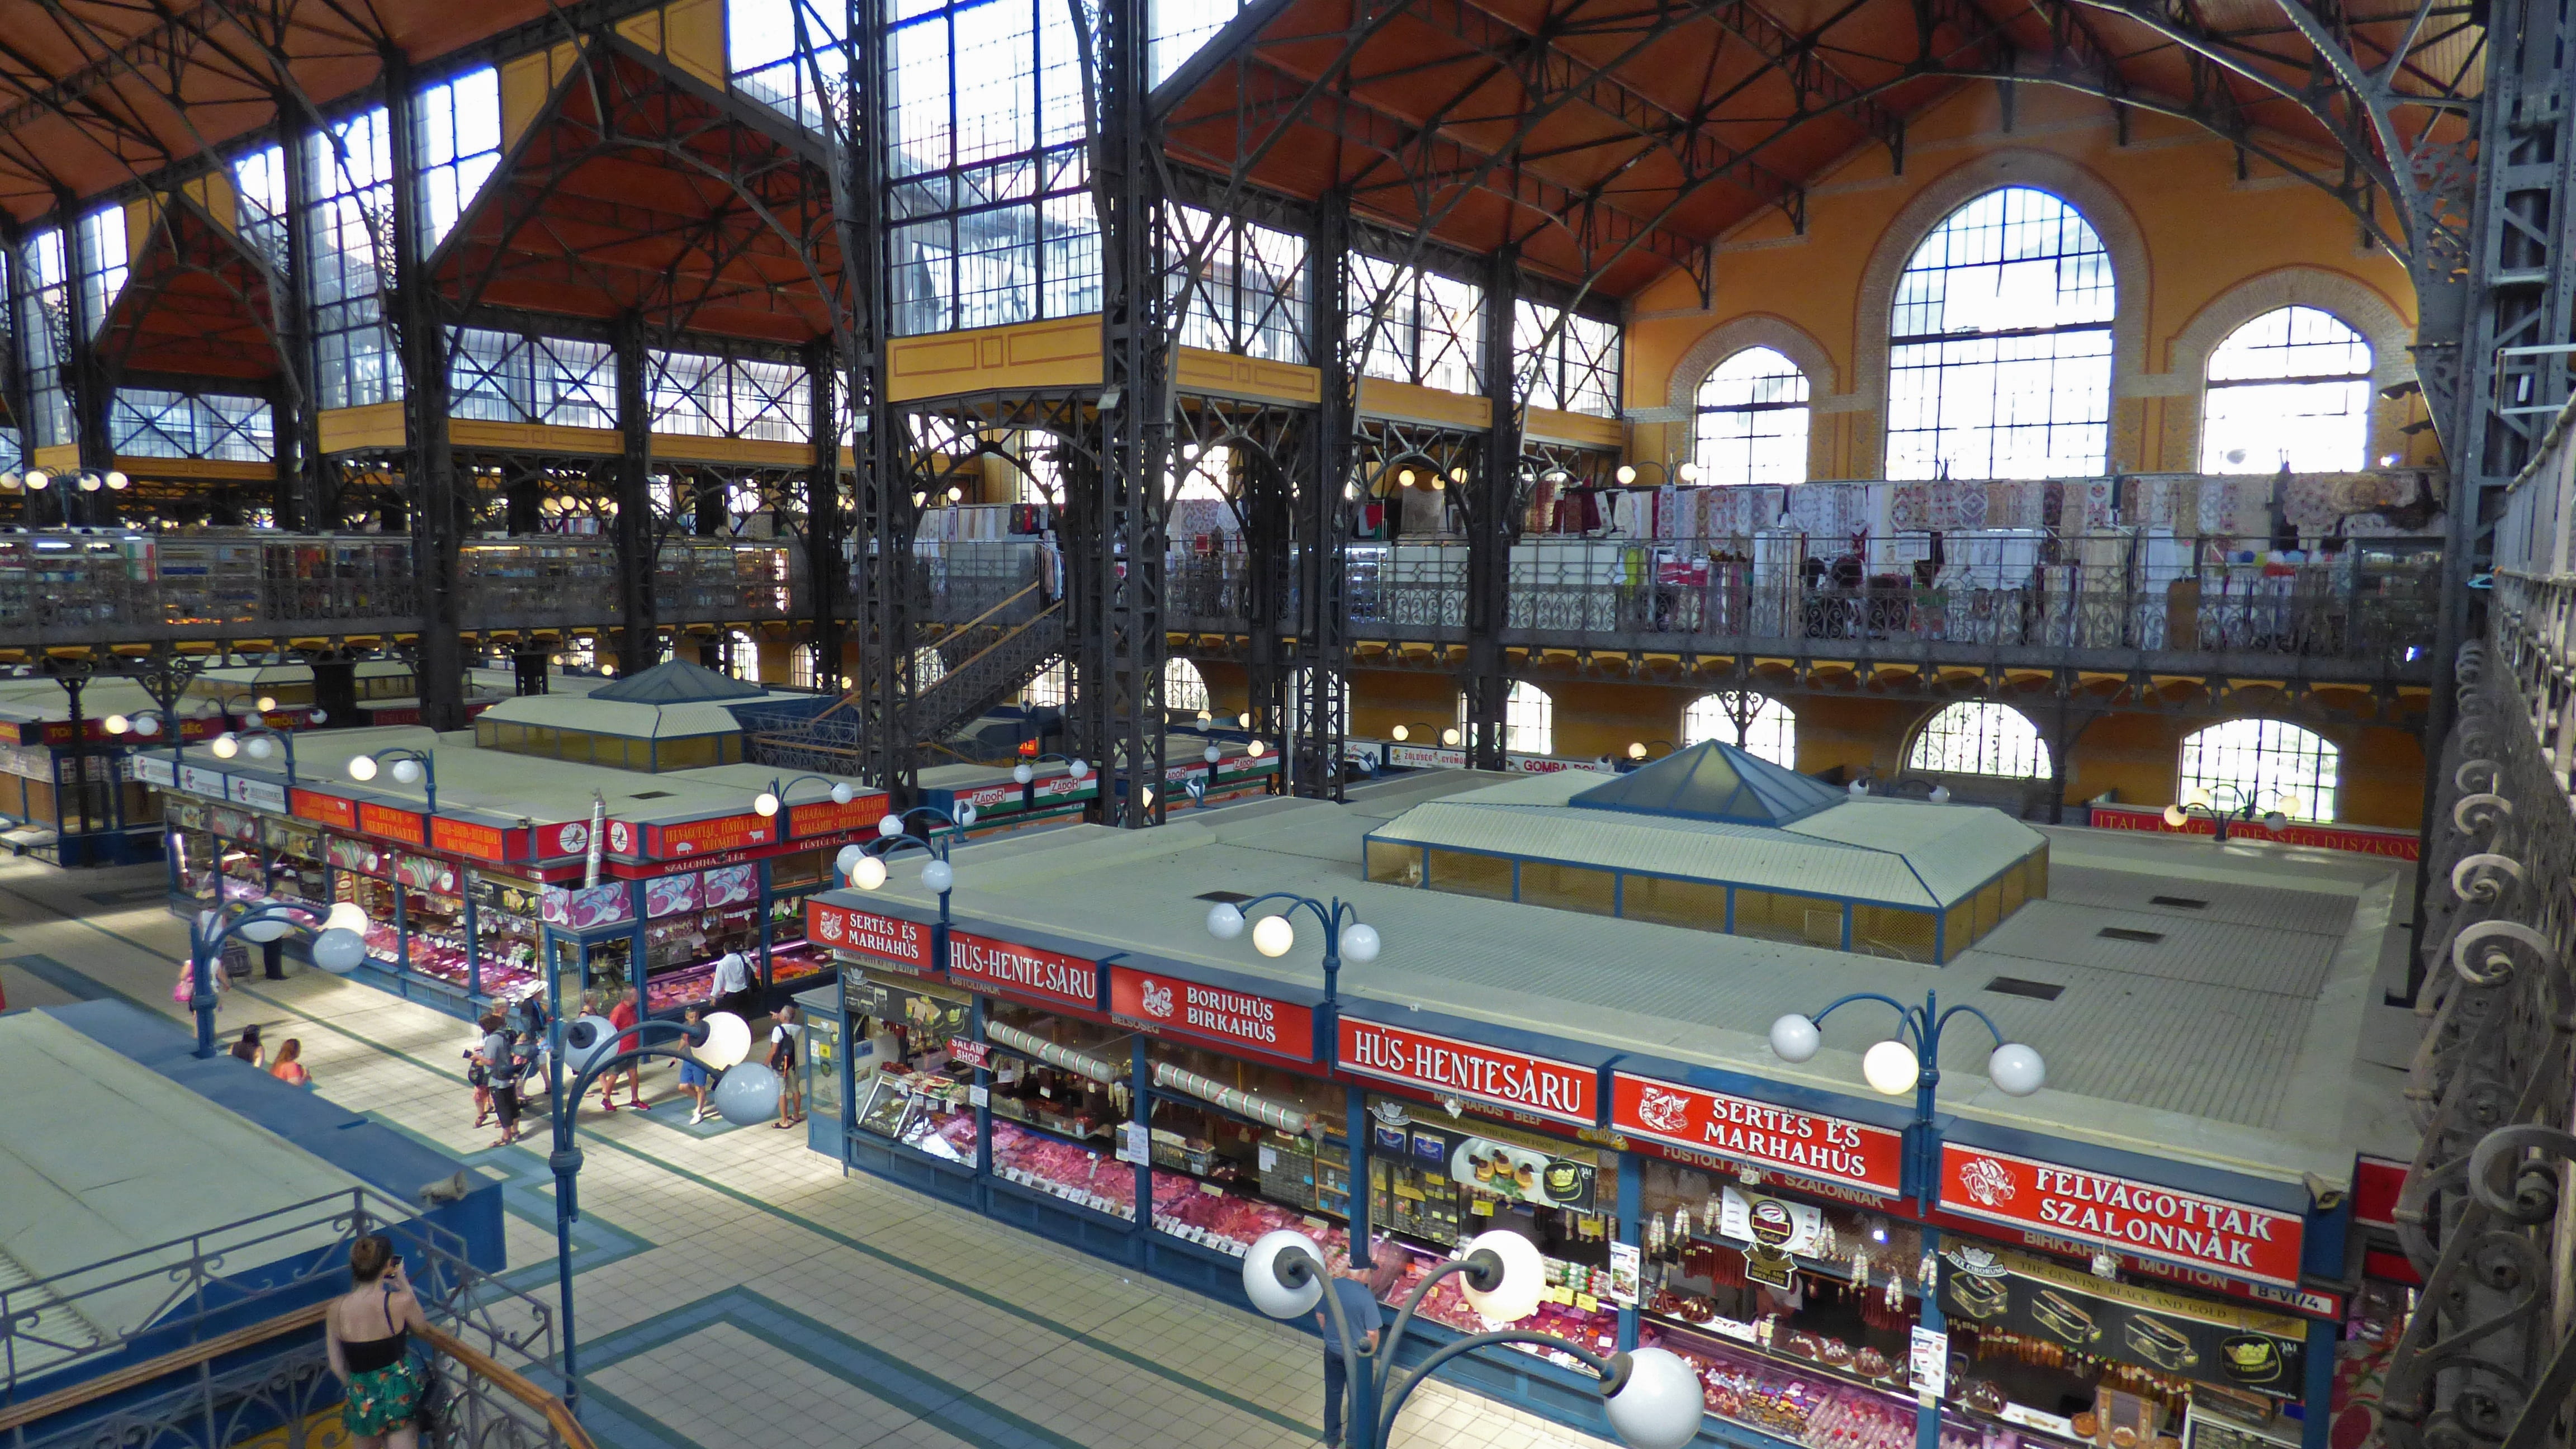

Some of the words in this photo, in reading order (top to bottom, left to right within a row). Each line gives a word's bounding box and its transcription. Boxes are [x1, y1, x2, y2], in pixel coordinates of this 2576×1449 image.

[1523, 760, 1567, 773] GOMBA
[850, 913, 894, 936] SERTÉS
[902, 921, 917, 941] ÉS
[849, 930, 919, 960] MARHAHÚS
[1187, 1007, 1276, 1043] BIRKAHÚS
[951, 1038, 984, 1056] SALAMI
[956, 1049, 981, 1065] SHOP
[1355, 1029, 1581, 1114] HÚS-HENTESÁRU
[1513, 1111, 1543, 1126] BEEF
[1713, 1098, 1813, 1139] SERTÉS
[1826, 1118, 1861, 1148] ÉS
[1703, 1121, 1866, 1177] MARHAHÚS
[2035, 1167, 2272, 1242] FELVÁGOTTAK
[2040, 1198, 2252, 1268] SZALONNÁK
[2138, 1257, 2229, 1290] MUTTON
[2189, 1304, 2227, 1318] GOLD
